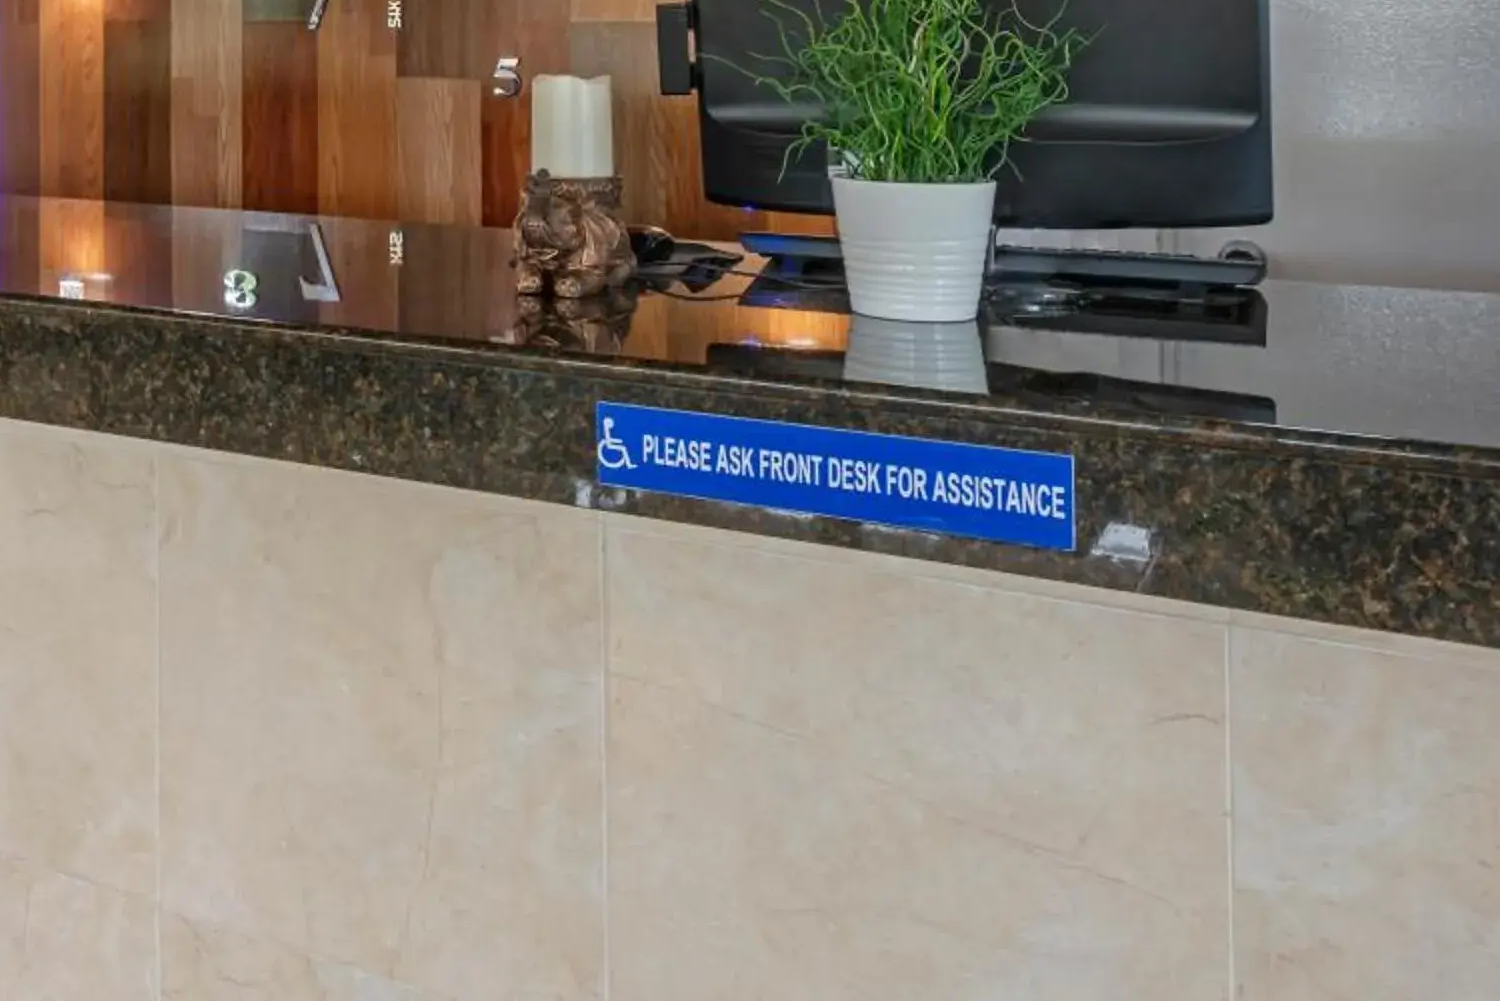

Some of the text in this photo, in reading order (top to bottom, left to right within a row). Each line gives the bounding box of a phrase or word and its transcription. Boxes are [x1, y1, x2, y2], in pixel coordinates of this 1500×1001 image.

[493, 58, 521, 97] 5
[642, 434, 1066, 519] PLEASE ASK FRONT DESK FOR ASSISTANCE
